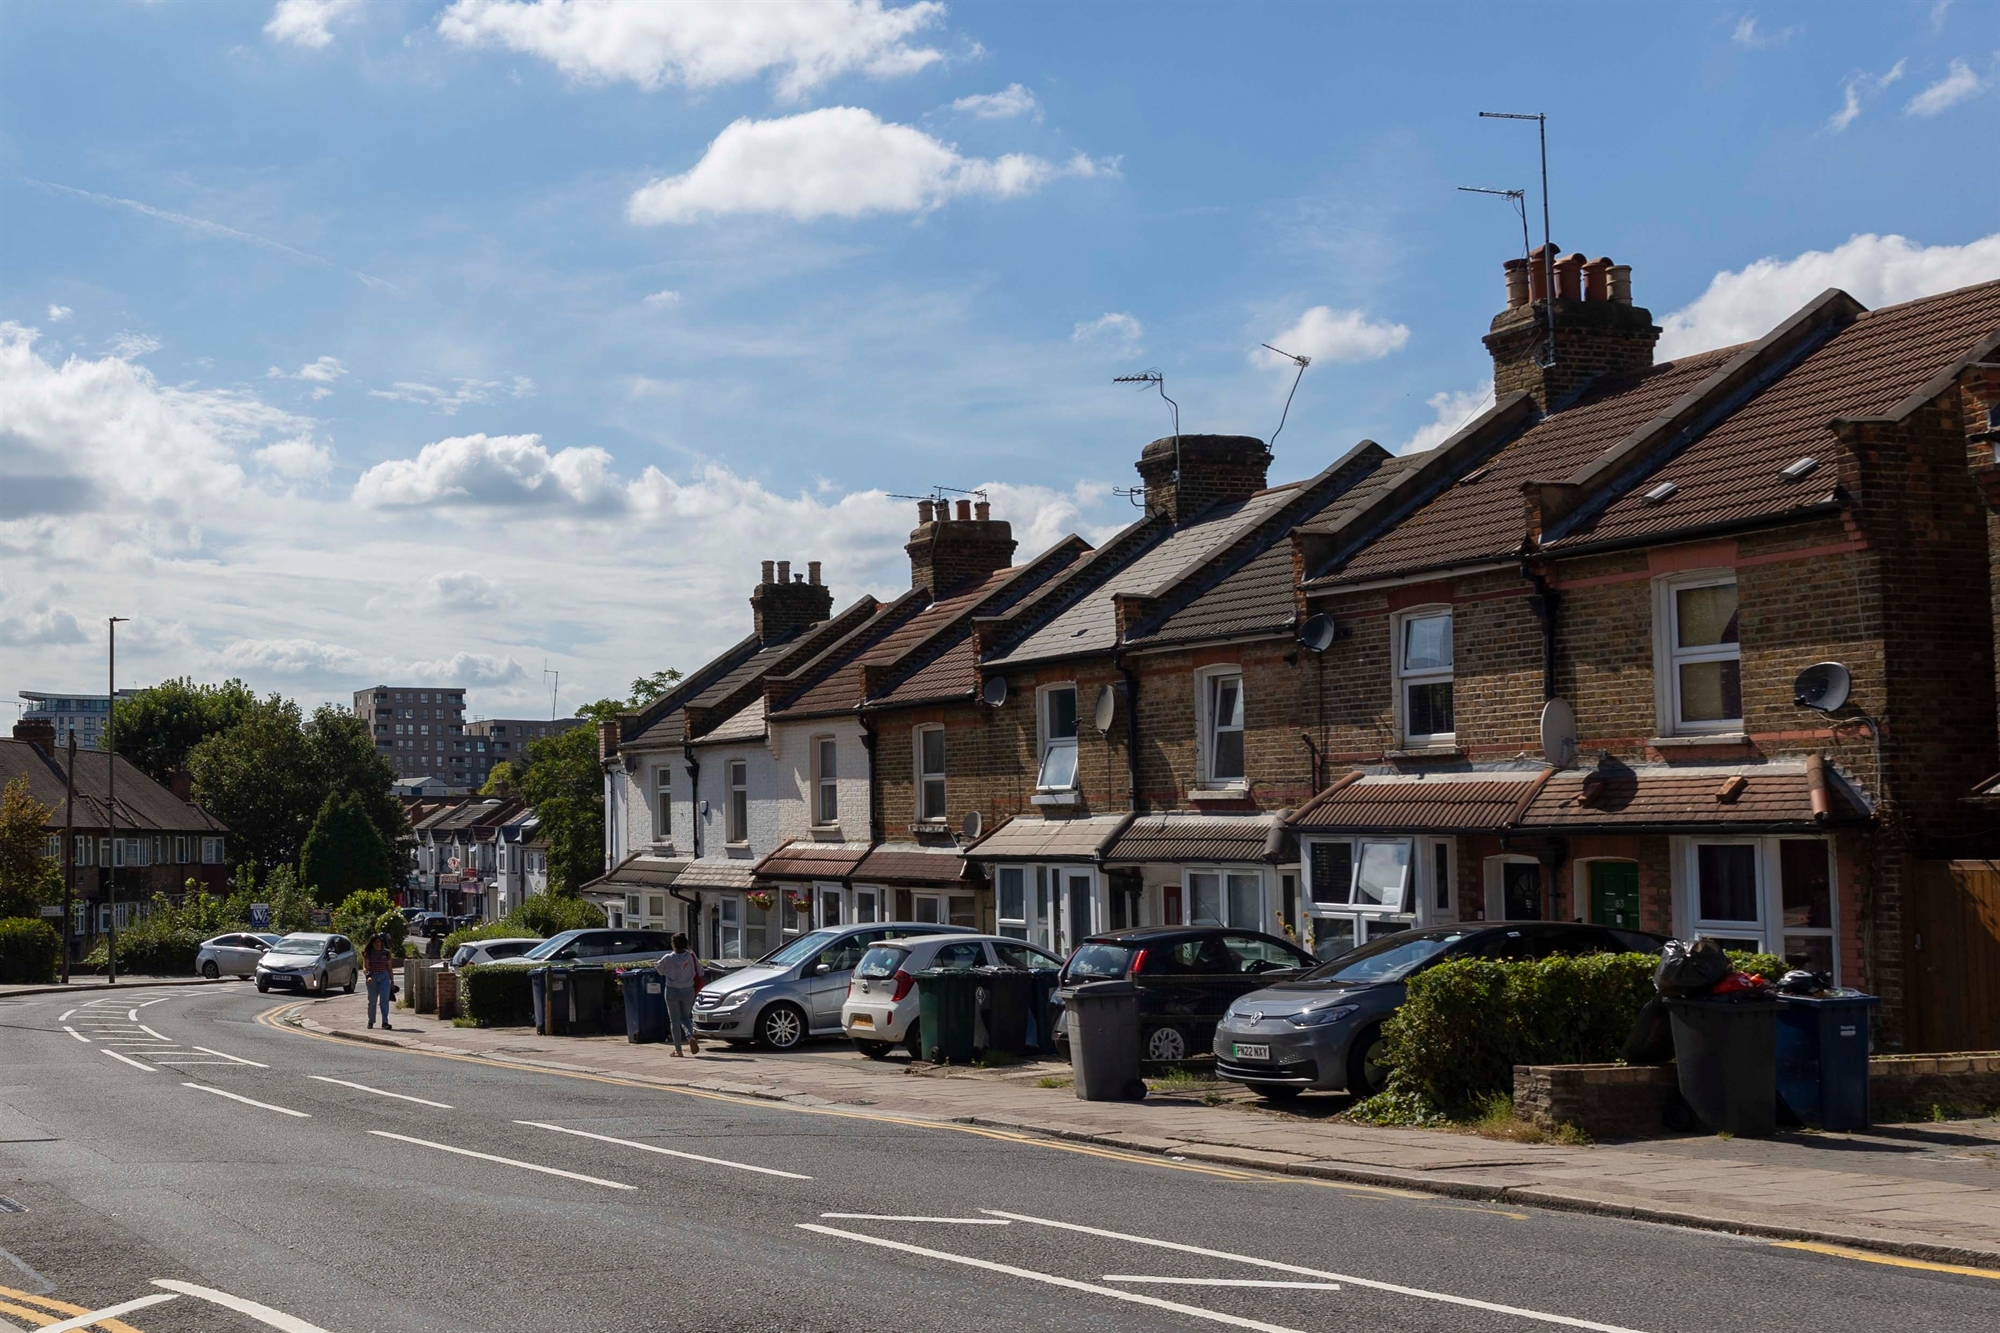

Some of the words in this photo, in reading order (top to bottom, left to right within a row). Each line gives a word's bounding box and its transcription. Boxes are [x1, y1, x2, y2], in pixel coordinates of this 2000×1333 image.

[1615, 899, 1624, 908] 83
[1237, 1046, 1253, 1057] PN22
[1254, 1046, 1267, 1058] NXY
